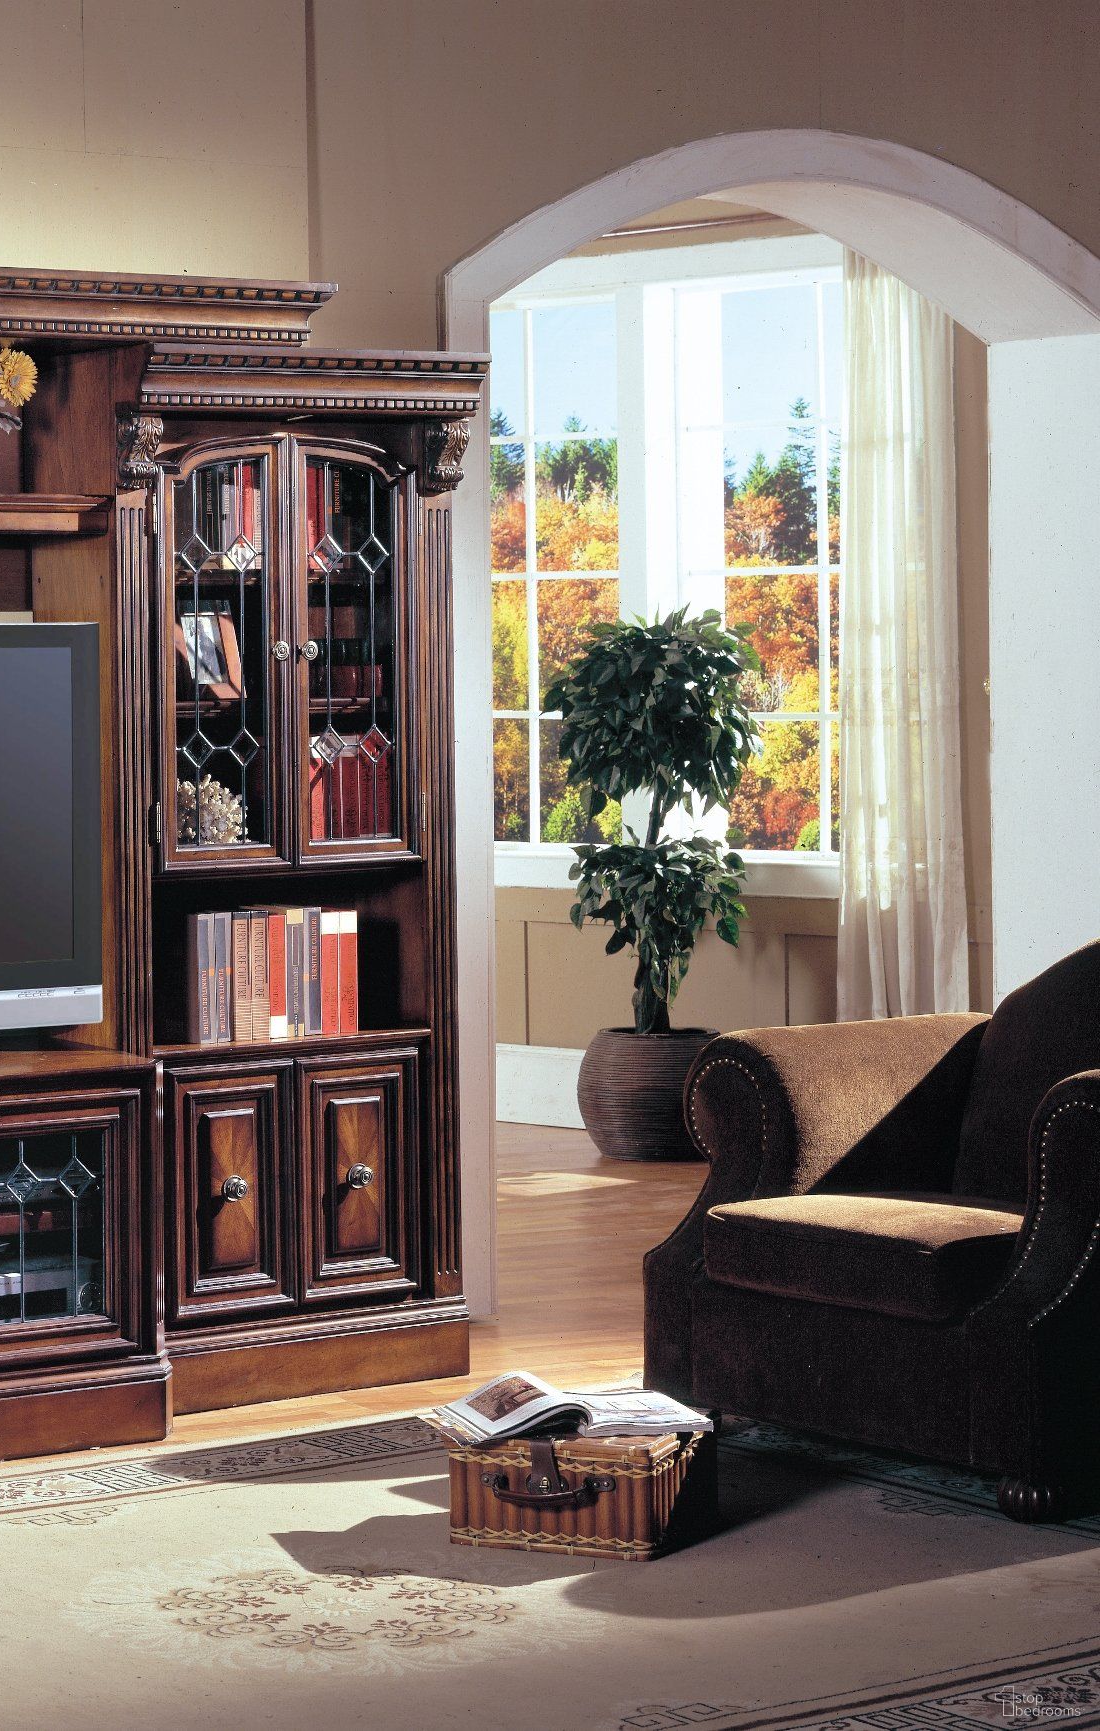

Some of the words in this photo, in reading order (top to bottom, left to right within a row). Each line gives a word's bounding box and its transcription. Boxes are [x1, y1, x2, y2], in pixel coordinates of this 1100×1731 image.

[236, 922, 247, 964] FURNITURE
[254, 922, 264, 964] FURNITURE
[237, 966, 247, 1000] CULTURE
[254, 964, 264, 998] CULTURE
